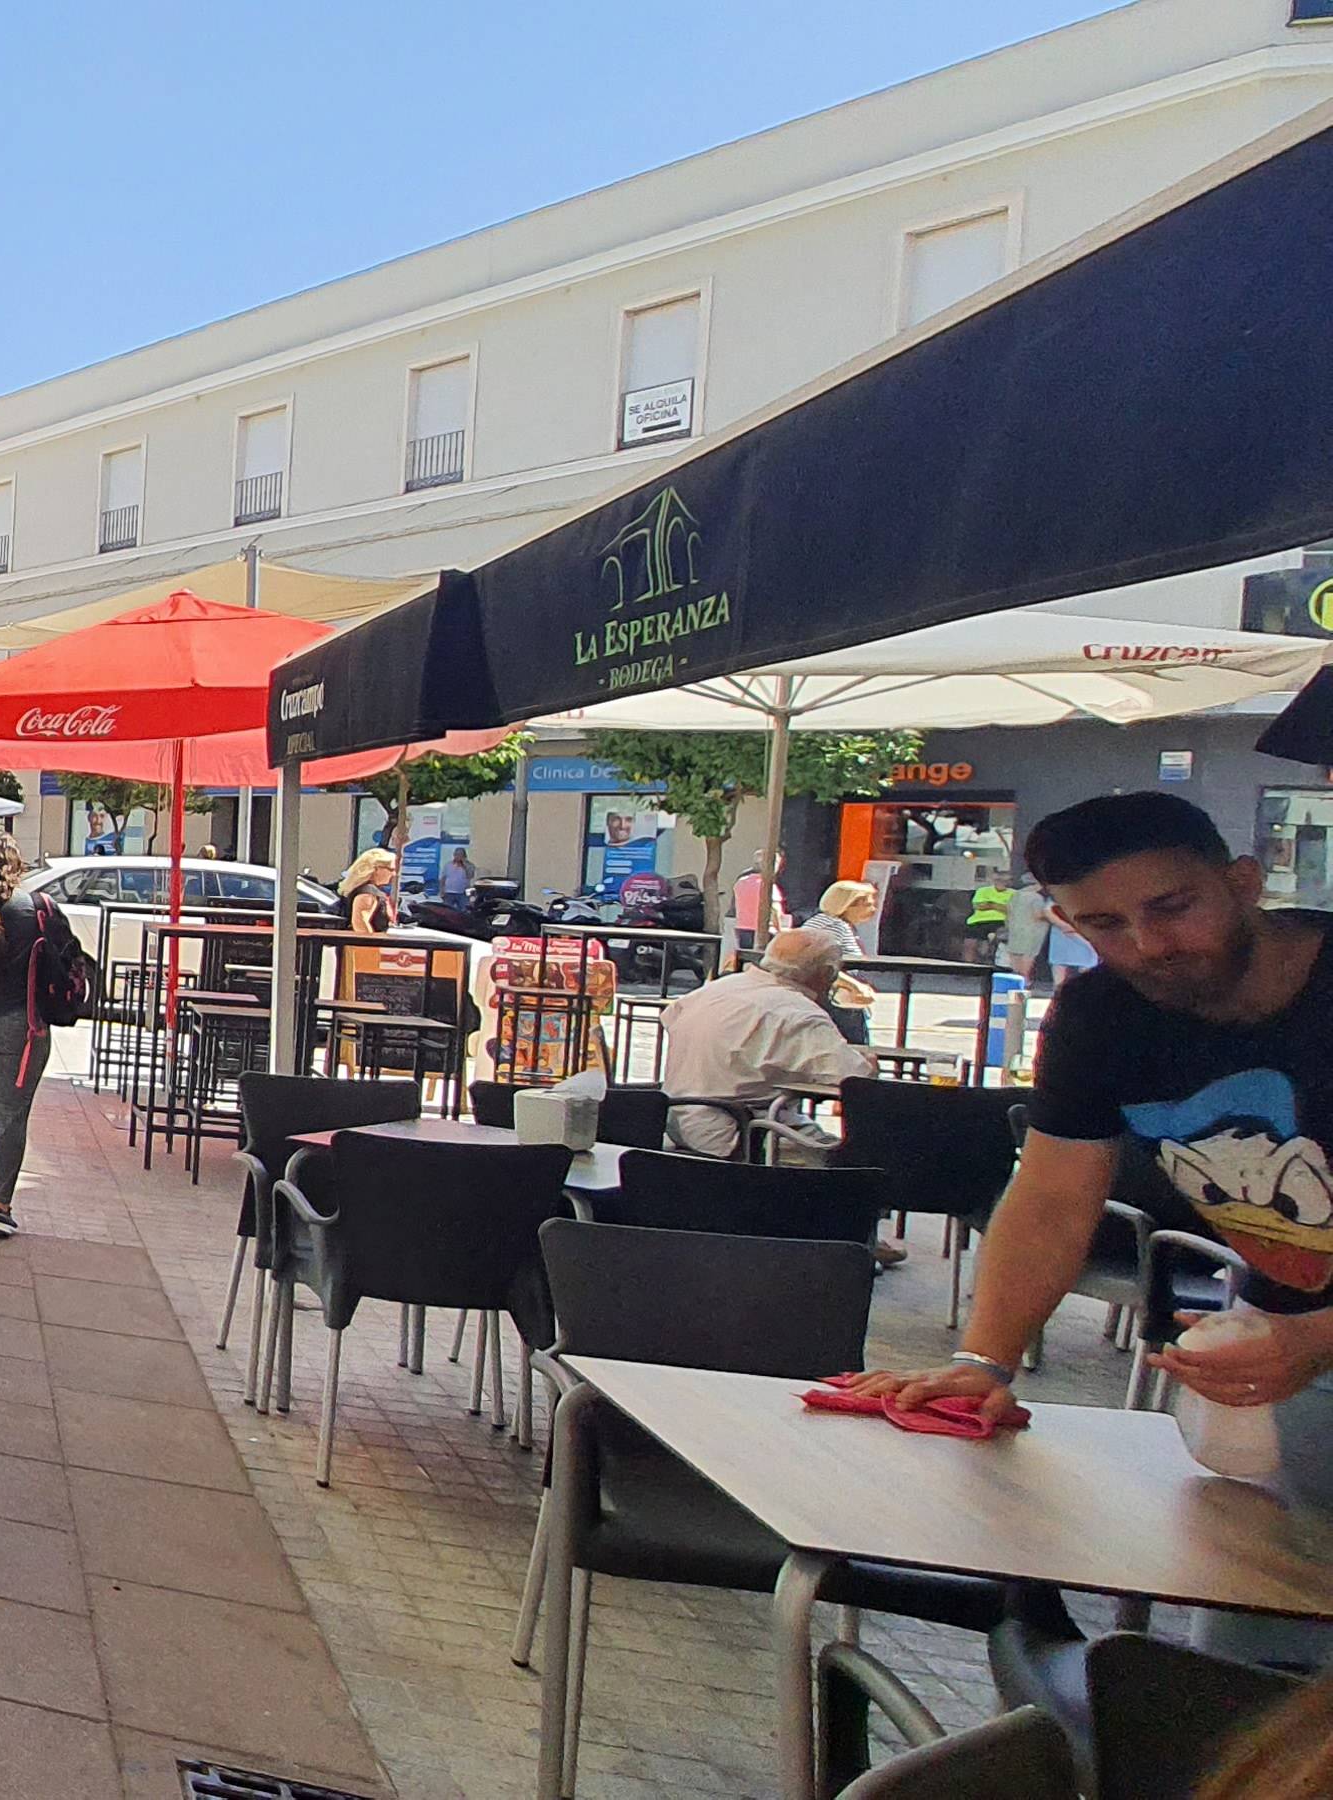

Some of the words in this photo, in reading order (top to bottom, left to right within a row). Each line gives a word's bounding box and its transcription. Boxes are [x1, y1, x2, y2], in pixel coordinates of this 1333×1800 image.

[628, 404, 641, 416] SE
[643, 394, 687, 412] ALQUILA
[636, 407, 679, 425] OFICINA
[574, 631, 598, 665] LA
[603, 591, 730, 656] ESPERANZA
[608, 653, 675, 690] BODEGA
[892, 762, 973, 788] ange
